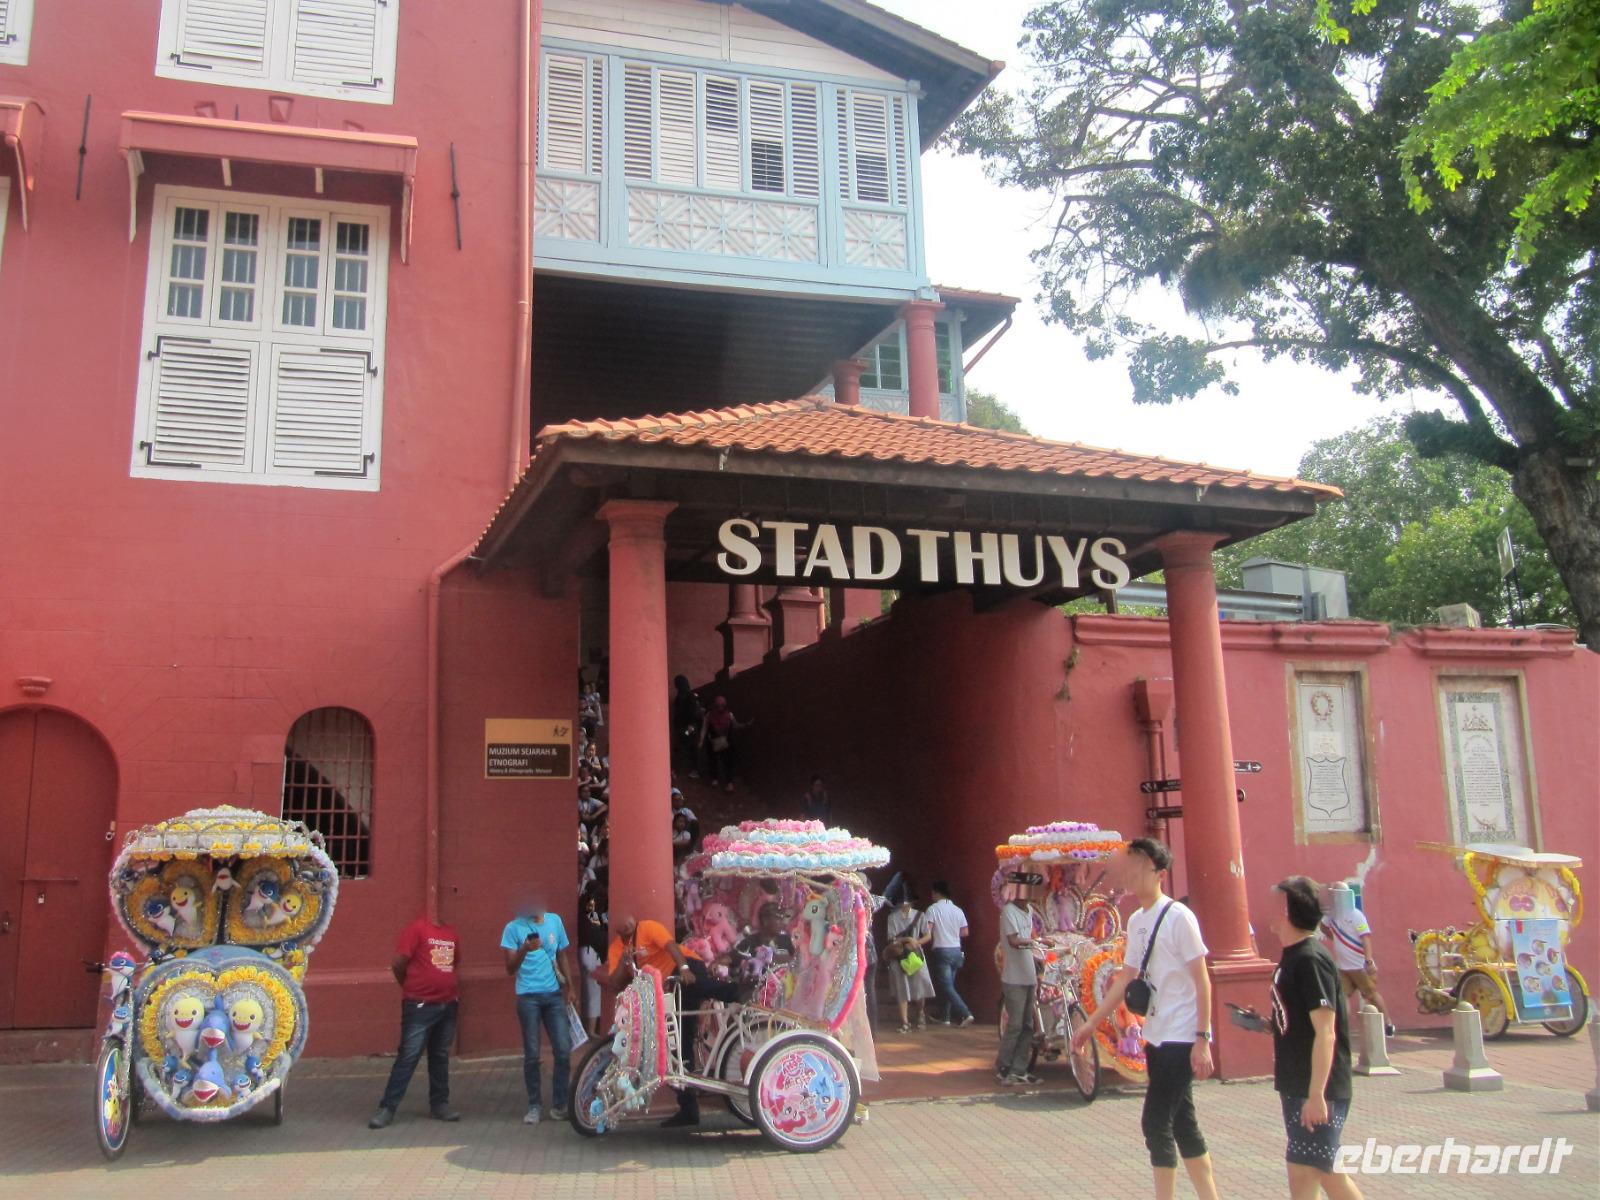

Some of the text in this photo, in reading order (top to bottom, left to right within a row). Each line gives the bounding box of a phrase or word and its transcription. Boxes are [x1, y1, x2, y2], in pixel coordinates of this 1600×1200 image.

[717, 517, 1131, 591] STADTHUYS
[489, 747, 557, 756] MUZIUM SEJARAH &
[489, 758, 528, 767] ETNOGRAFI
